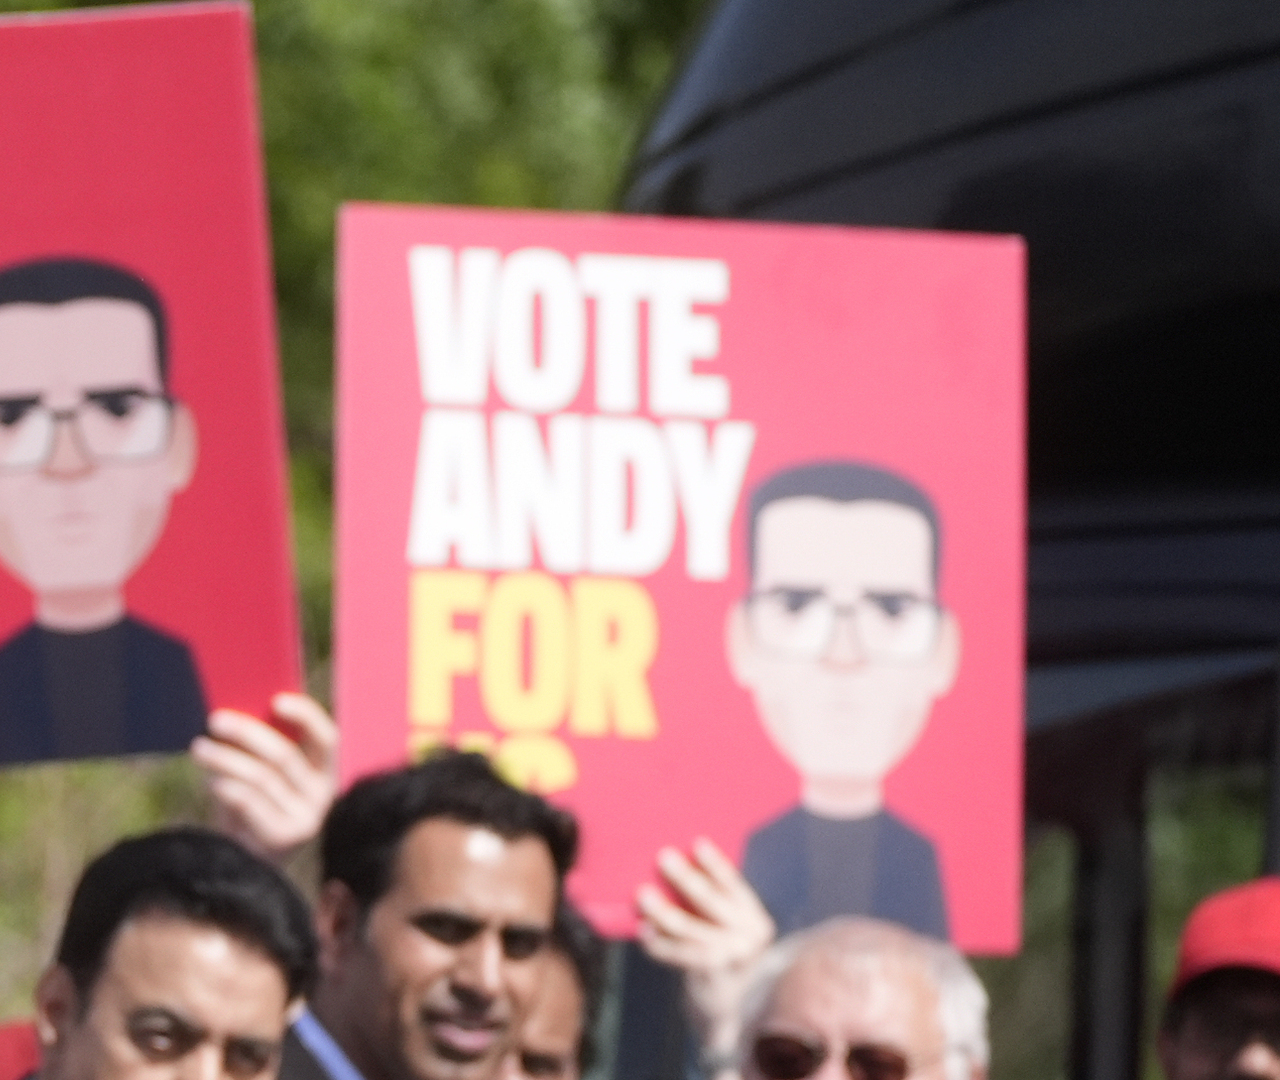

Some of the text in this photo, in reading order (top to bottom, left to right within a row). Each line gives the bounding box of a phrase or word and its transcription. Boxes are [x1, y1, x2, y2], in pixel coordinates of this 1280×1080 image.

[406, 245, 730, 421] VOTE
[405, 408, 757, 581] ANDY
[408, 568, 661, 740] FOR
